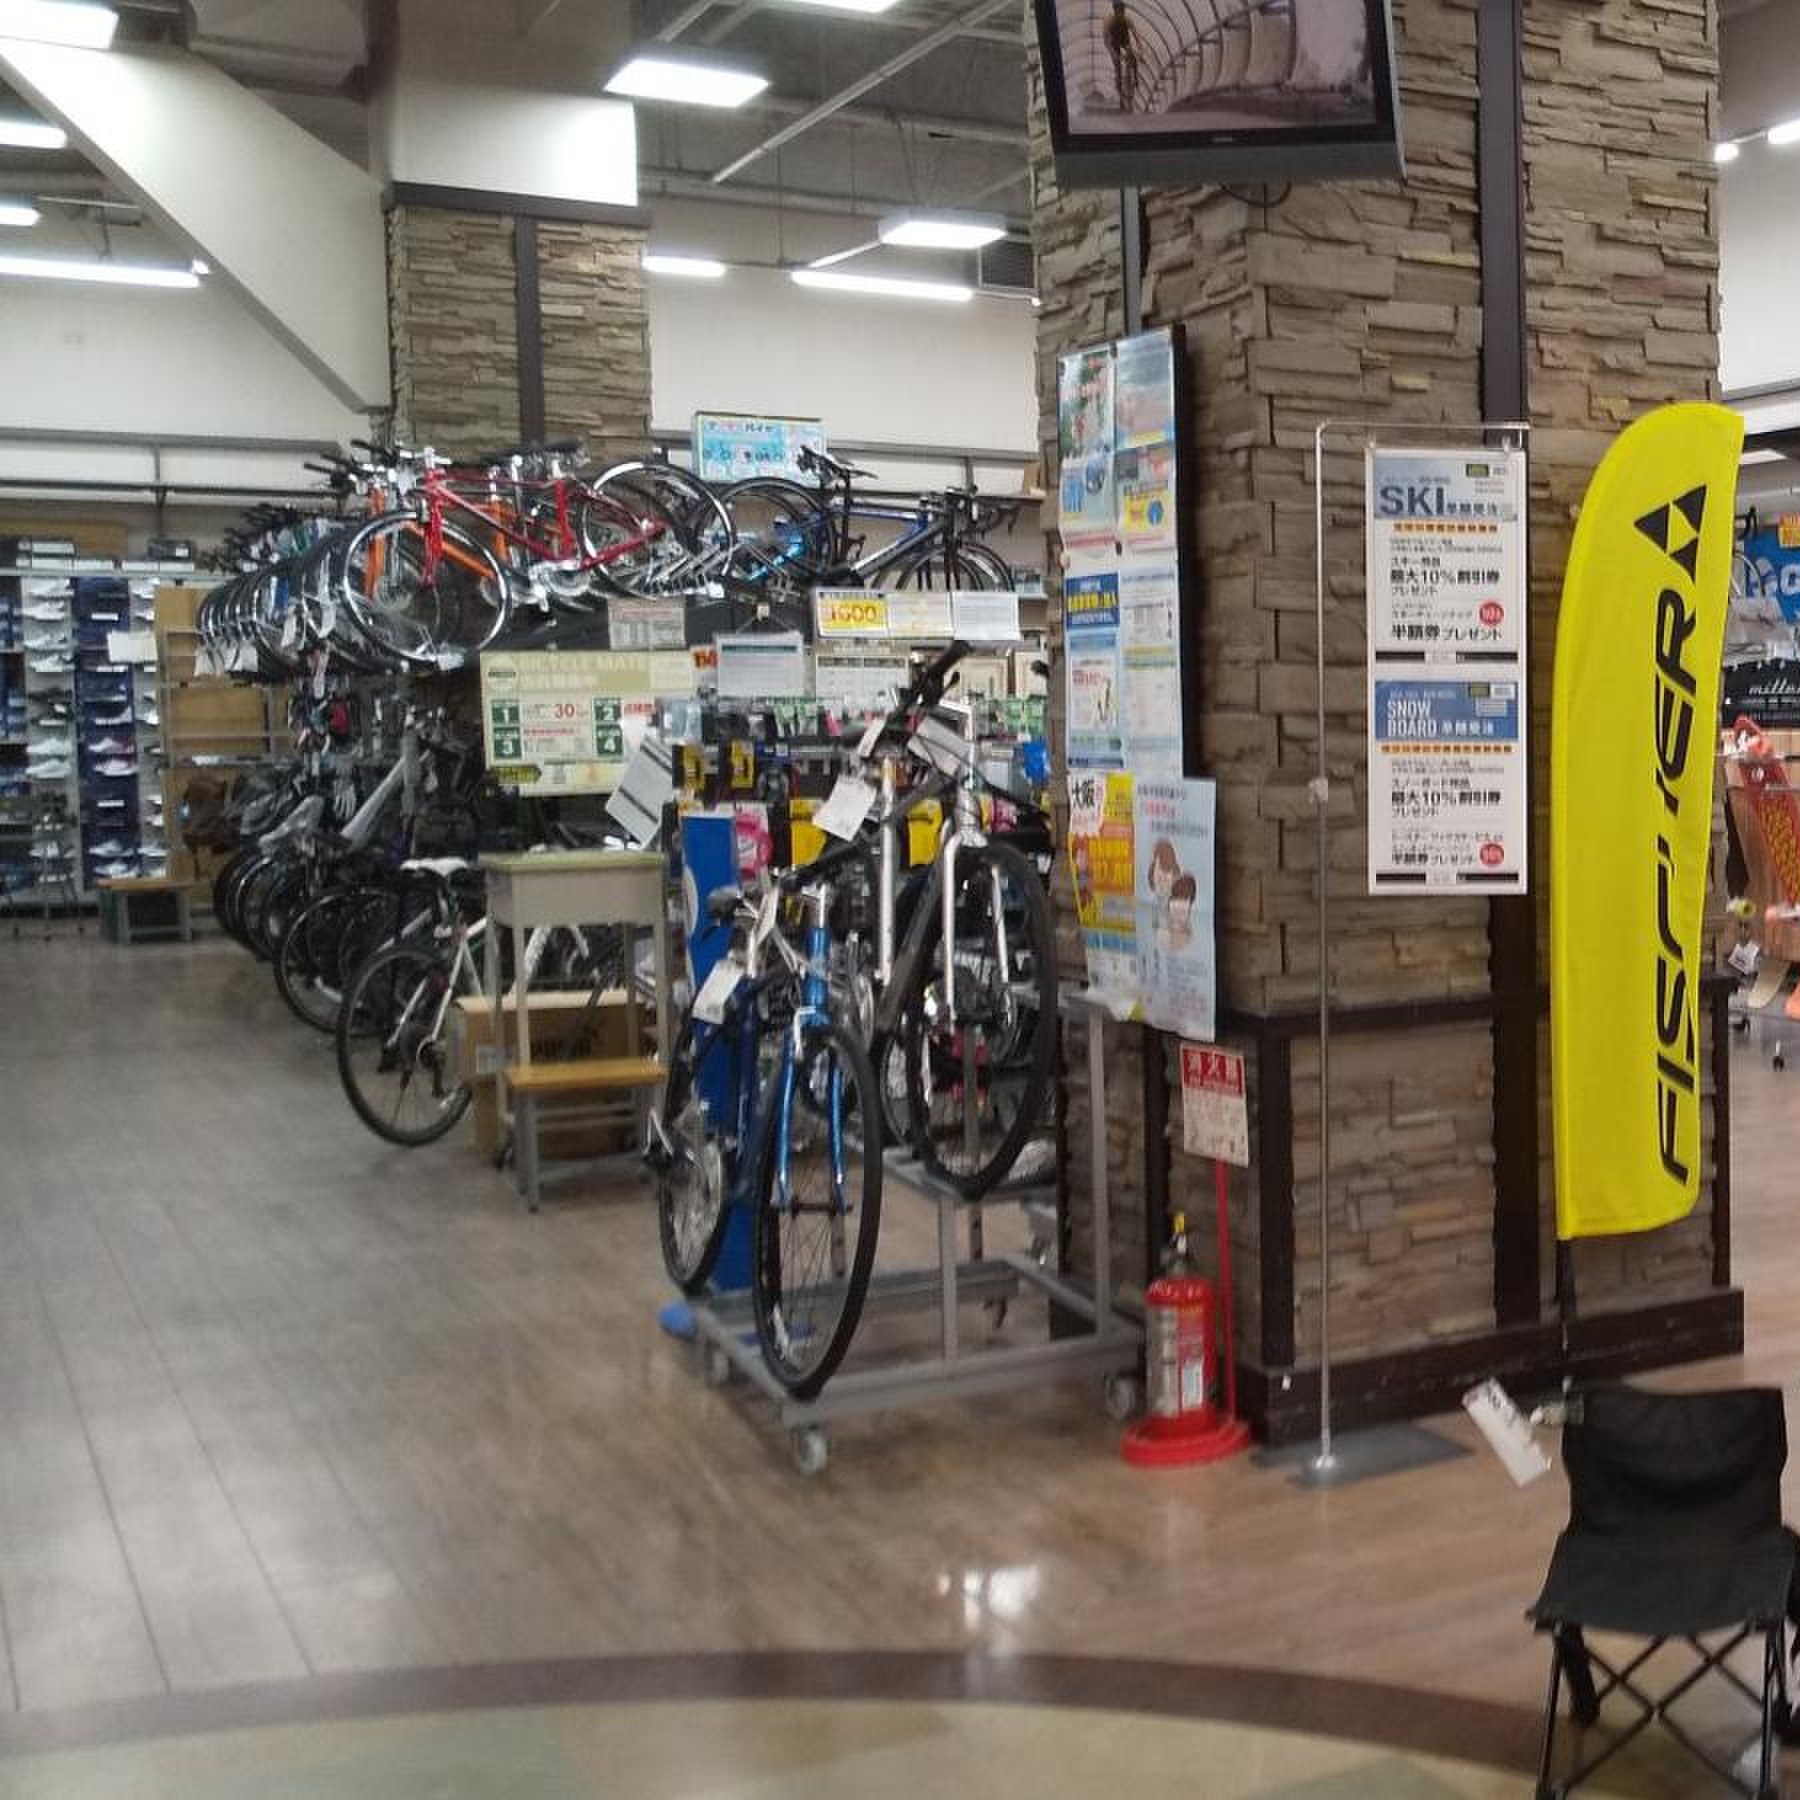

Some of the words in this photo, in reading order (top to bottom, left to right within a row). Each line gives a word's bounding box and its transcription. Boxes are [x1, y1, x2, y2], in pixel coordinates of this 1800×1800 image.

[1380, 486, 1444, 516] SKI
[1387, 700, 1431, 718] SNOW
[1387, 719, 1437, 737] BOARD
